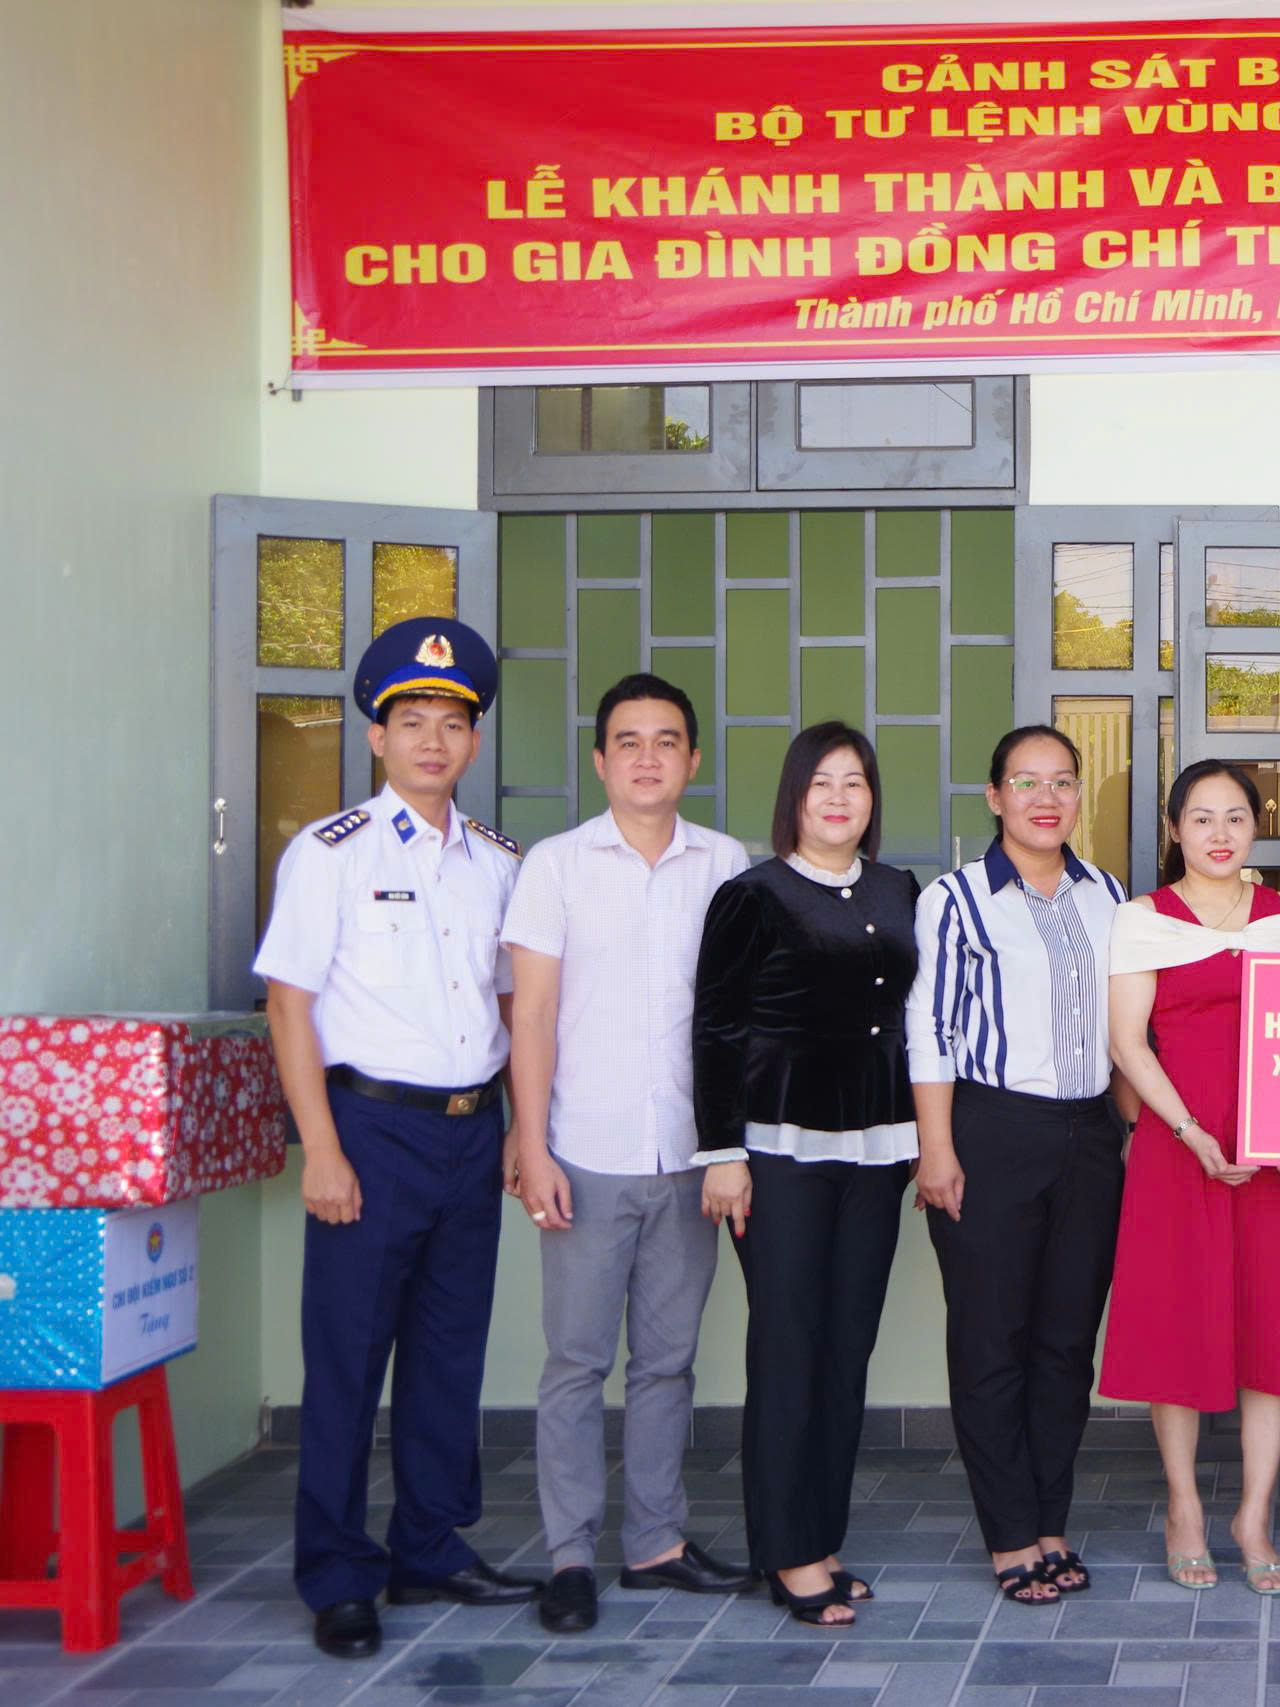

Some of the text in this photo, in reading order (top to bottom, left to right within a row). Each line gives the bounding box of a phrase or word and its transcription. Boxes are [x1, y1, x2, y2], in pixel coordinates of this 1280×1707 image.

[881, 53, 1066, 93] CẢNH
[1089, 52, 1217, 89] SÁT
[714, 104, 804, 147] BỘ
[824, 105, 915, 140] TƯ
[930, 100, 1101, 144] LỆNH
[486, 163, 567, 220] LỄ
[591, 166, 842, 219] KHÁNH
[862, 162, 1106, 214] THÀNH
[1128, 158, 1224, 208] VÀ
[344, 242, 488, 287] CHO
[511, 239, 634, 283] GIA
[653, 229, 833, 281] ĐÌNH
[853, 220, 1057, 277] ĐỒNG
[1080, 218, 1202, 271] CHÍ
[794, 295, 914, 330] Thành
[921, 288, 1006, 332] phố
[1007, 286, 1066, 327] Hồ
[1072, 287, 1142, 324] Chí
[1150, 286, 1265, 326] Minh,
